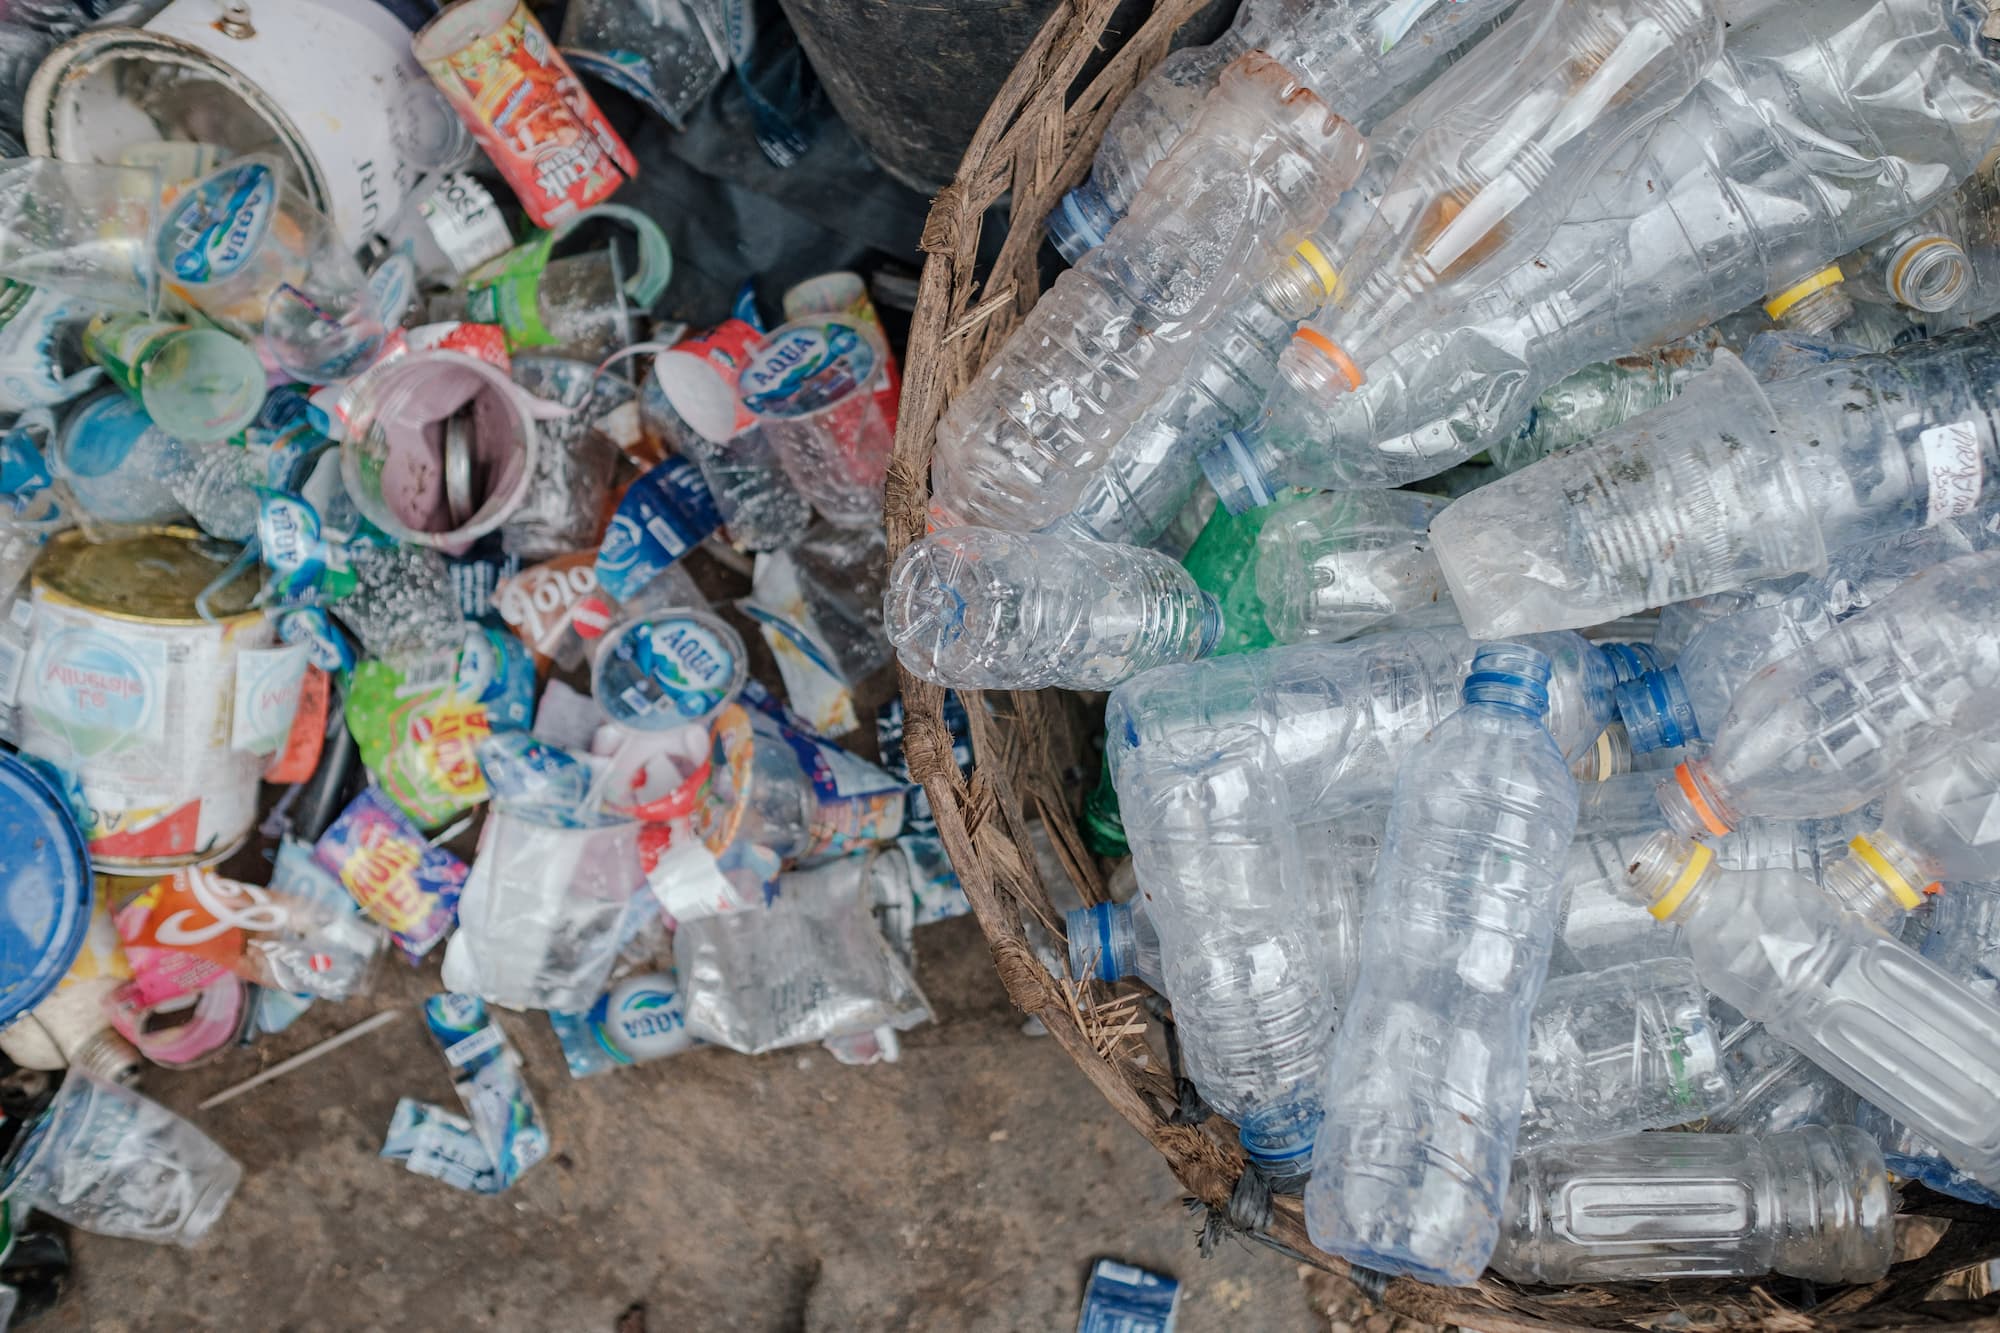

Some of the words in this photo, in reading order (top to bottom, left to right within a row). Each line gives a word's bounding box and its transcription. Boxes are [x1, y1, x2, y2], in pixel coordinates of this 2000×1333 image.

[220, 193, 262, 262] AQUA
[752, 337, 817, 387] AQUA
[271, 505, 298, 564] AQUA
[661, 628, 721, 681] AQUA
[622, 1008, 686, 1040] AQUA
